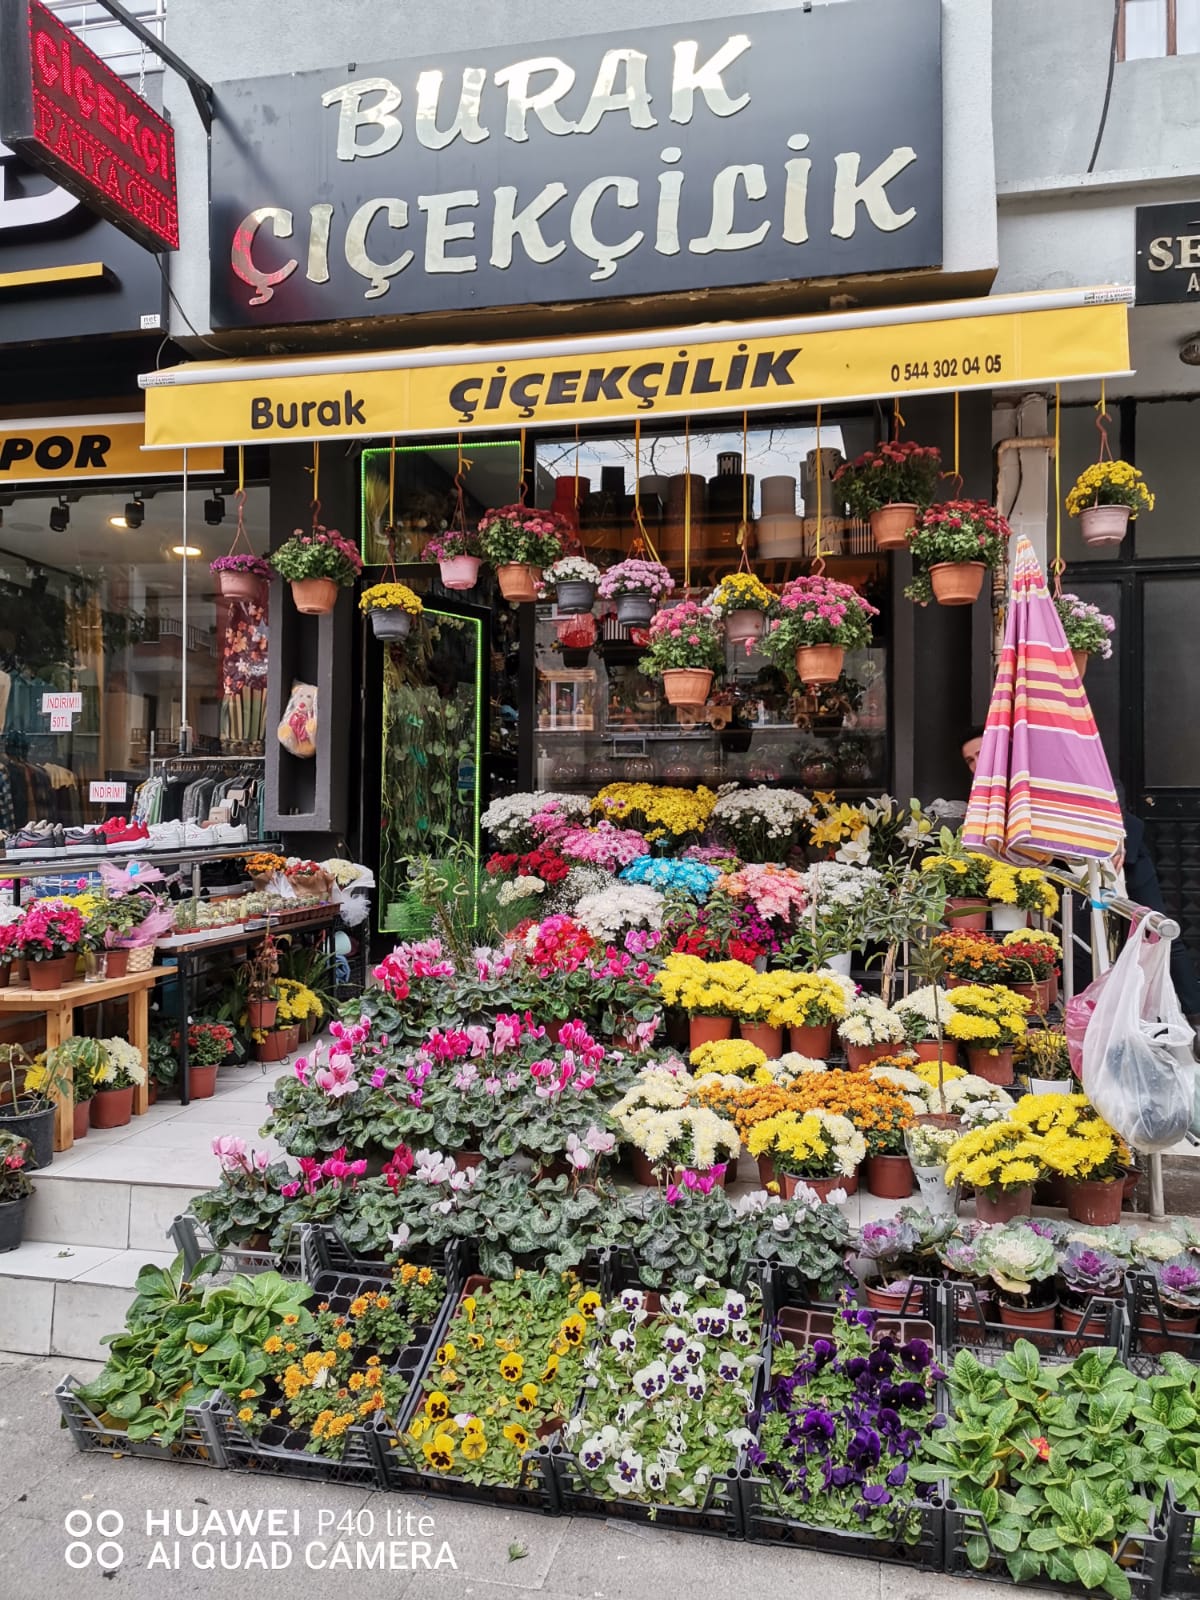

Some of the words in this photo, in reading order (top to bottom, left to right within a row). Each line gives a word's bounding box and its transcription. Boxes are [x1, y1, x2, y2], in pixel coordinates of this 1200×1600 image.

[322, 34, 752, 161] BURAK
[1148, 235, 1200, 271] SE
[251, 389, 365, 430] Burak
[448, 343, 804, 423] ÇİÇEKÇİLİK
[891, 364, 900, 382] 0
[904, 361, 929, 381] 544
[933, 358, 958, 378] 302
[962, 356, 980, 376] 04
[985, 354, 1002, 374] 05
